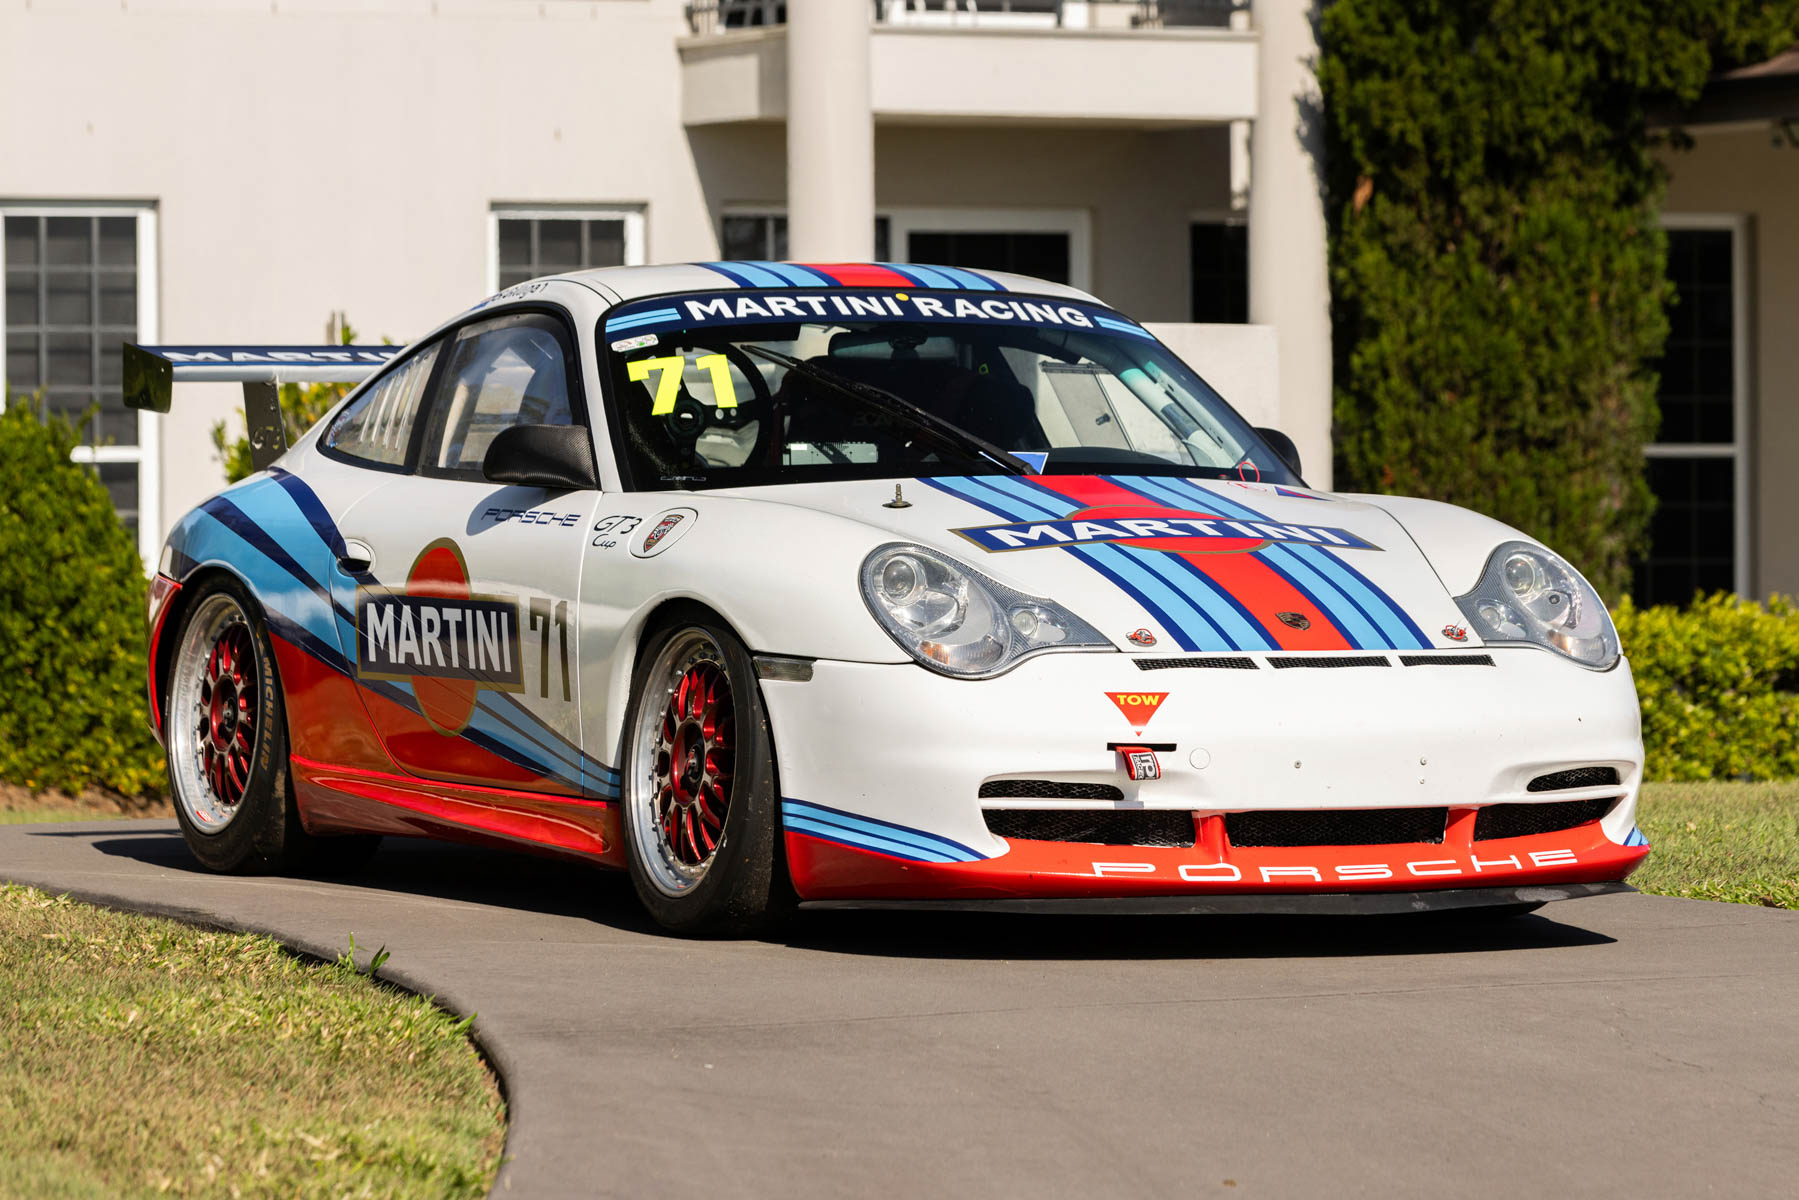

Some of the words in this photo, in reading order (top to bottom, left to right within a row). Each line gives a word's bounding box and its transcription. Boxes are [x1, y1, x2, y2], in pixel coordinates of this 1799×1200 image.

[683, 295, 905, 322] MARTINI
[911, 297, 1095, 329] RACING
[626, 353, 738, 416] 71
[481, 508, 581, 527] PORSCHE
[593, 515, 643, 535] GT3
[986, 517, 1349, 547] MARTINI
[592, 533, 617, 549] Cup
[366, 602, 513, 673] MARTINI
[529, 597, 572, 702] 71
[260, 656, 274, 771] MICHELIN
[1117, 694, 1159, 705] TOW
[1092, 849, 1578, 883] PORSCHE
